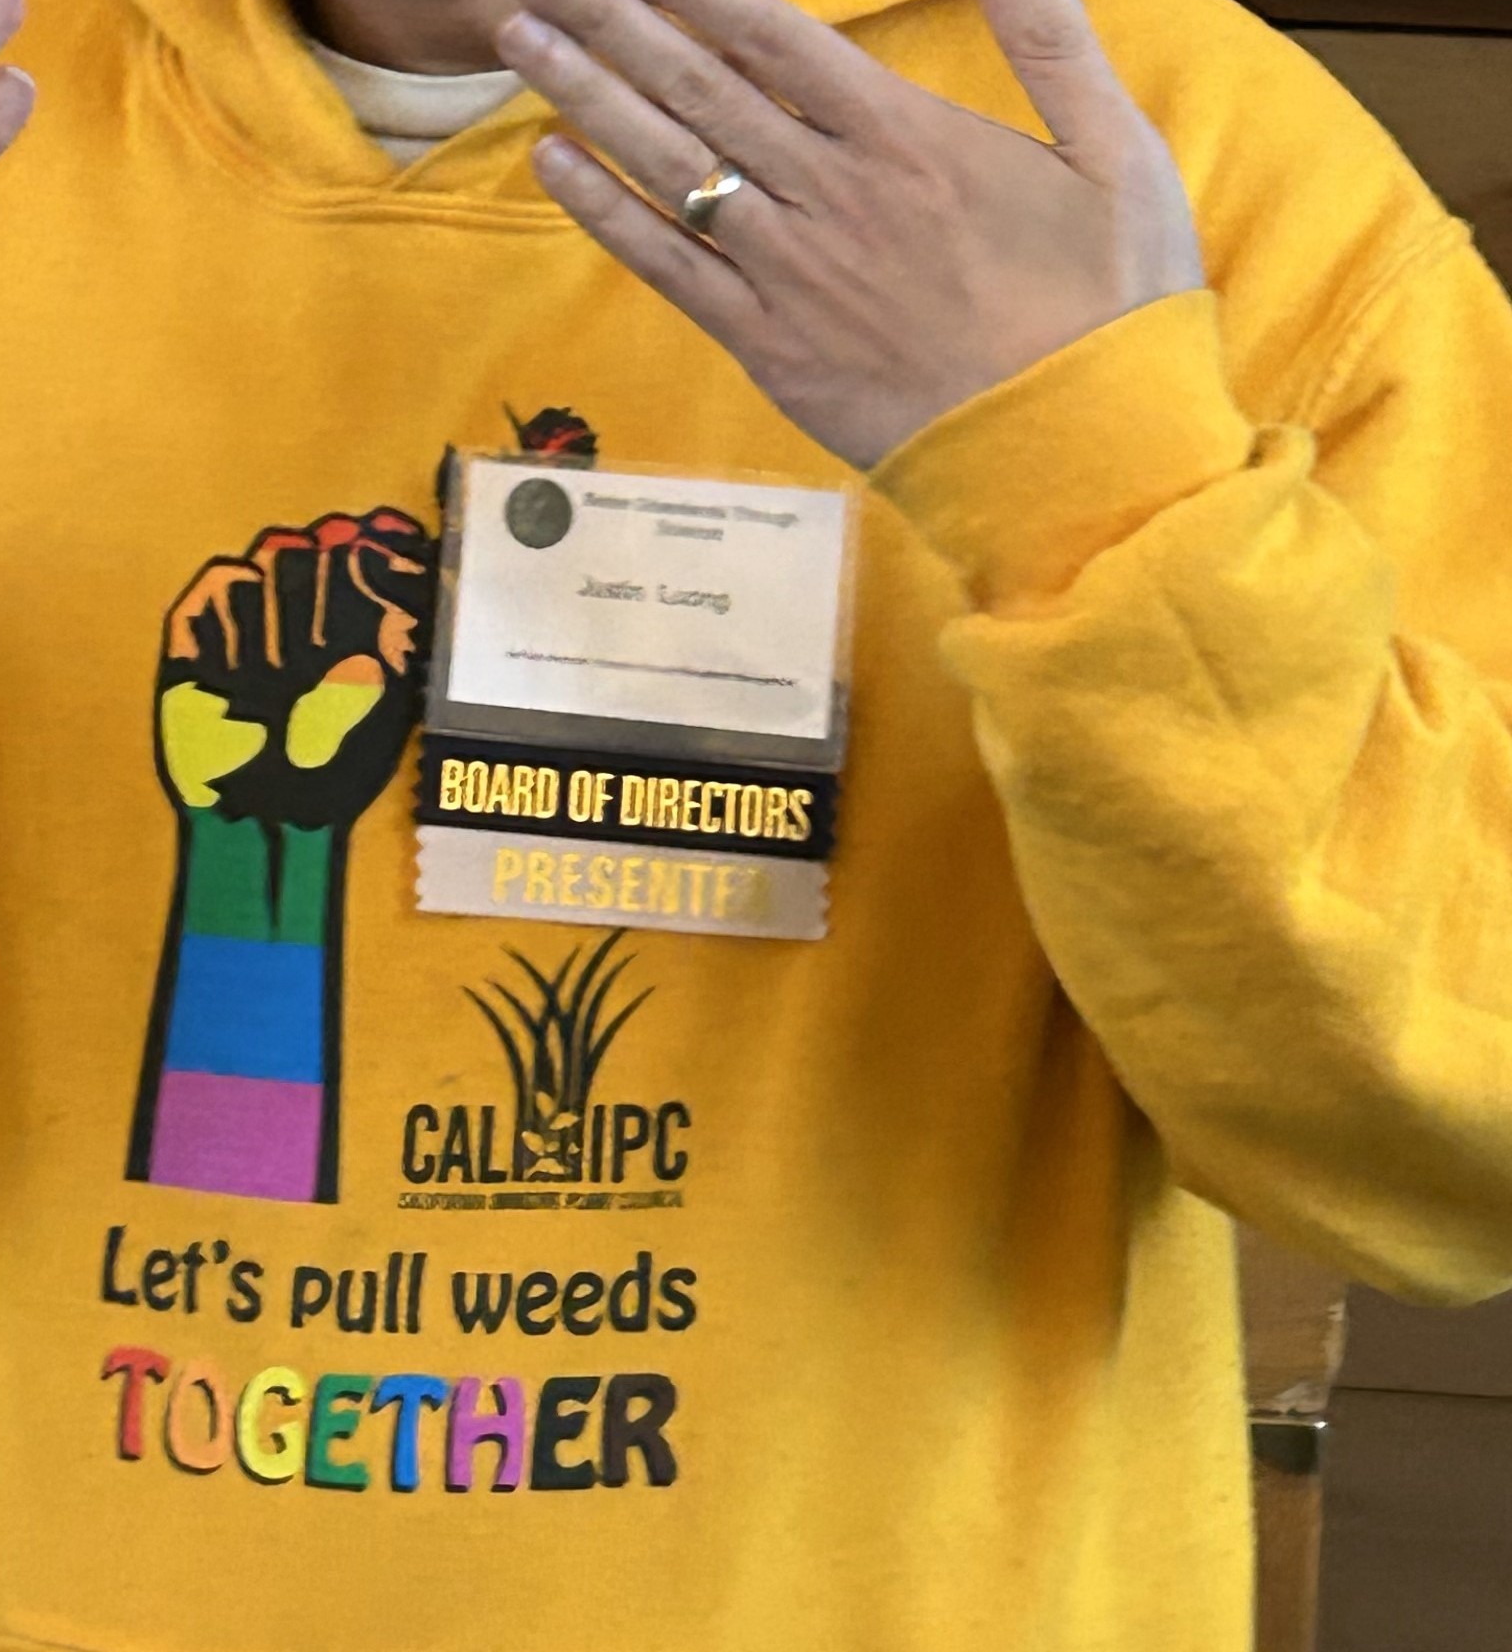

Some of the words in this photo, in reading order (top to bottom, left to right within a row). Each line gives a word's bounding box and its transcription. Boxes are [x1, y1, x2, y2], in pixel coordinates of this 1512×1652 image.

[439, 759, 560, 819] BOARD
[568, 770, 616, 823] OF
[618, 775, 814, 842] DIRECTORS
[492, 847, 775, 920] PRESENTE
[101, 1224, 265, 1323] Let's
[290, 1251, 428, 1335] pull
[450, 1250, 698, 1336] weeds
[101, 1345, 678, 1491] TOGETHER
